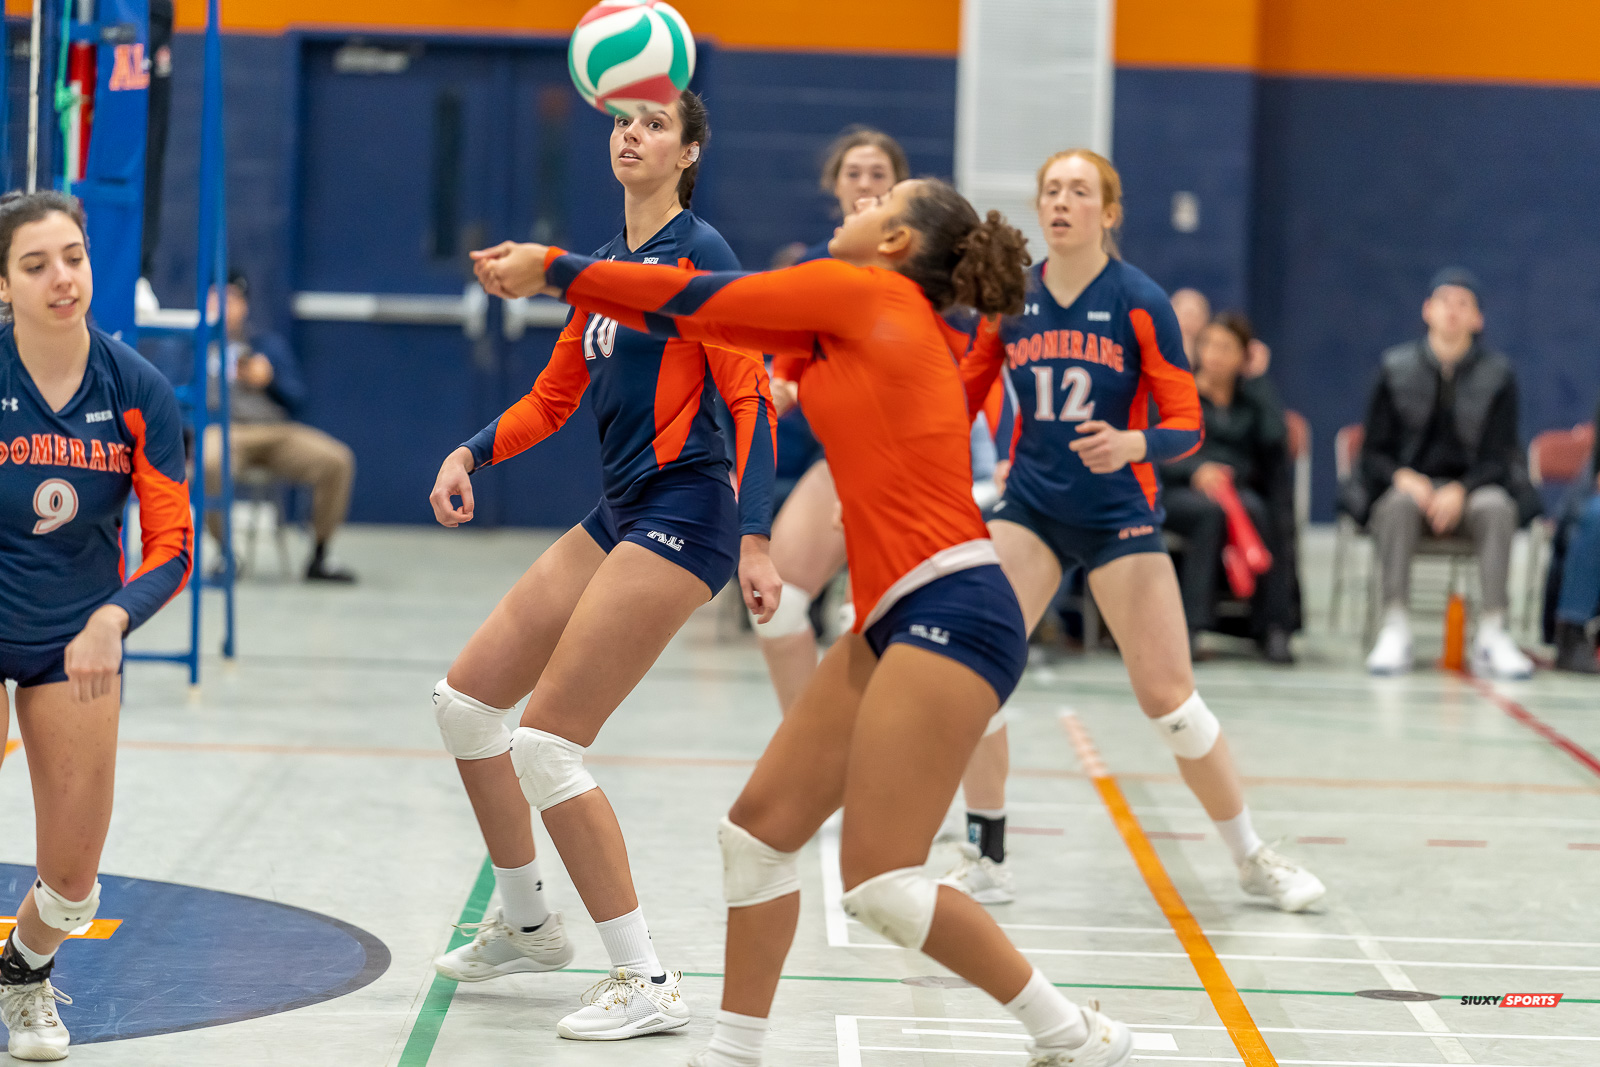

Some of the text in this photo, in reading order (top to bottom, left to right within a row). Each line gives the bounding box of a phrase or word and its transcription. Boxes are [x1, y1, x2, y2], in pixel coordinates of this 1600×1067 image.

[584, 313, 619, 360] 10
[1030, 366, 1096, 422] 12
[32, 477, 79, 535] 9
